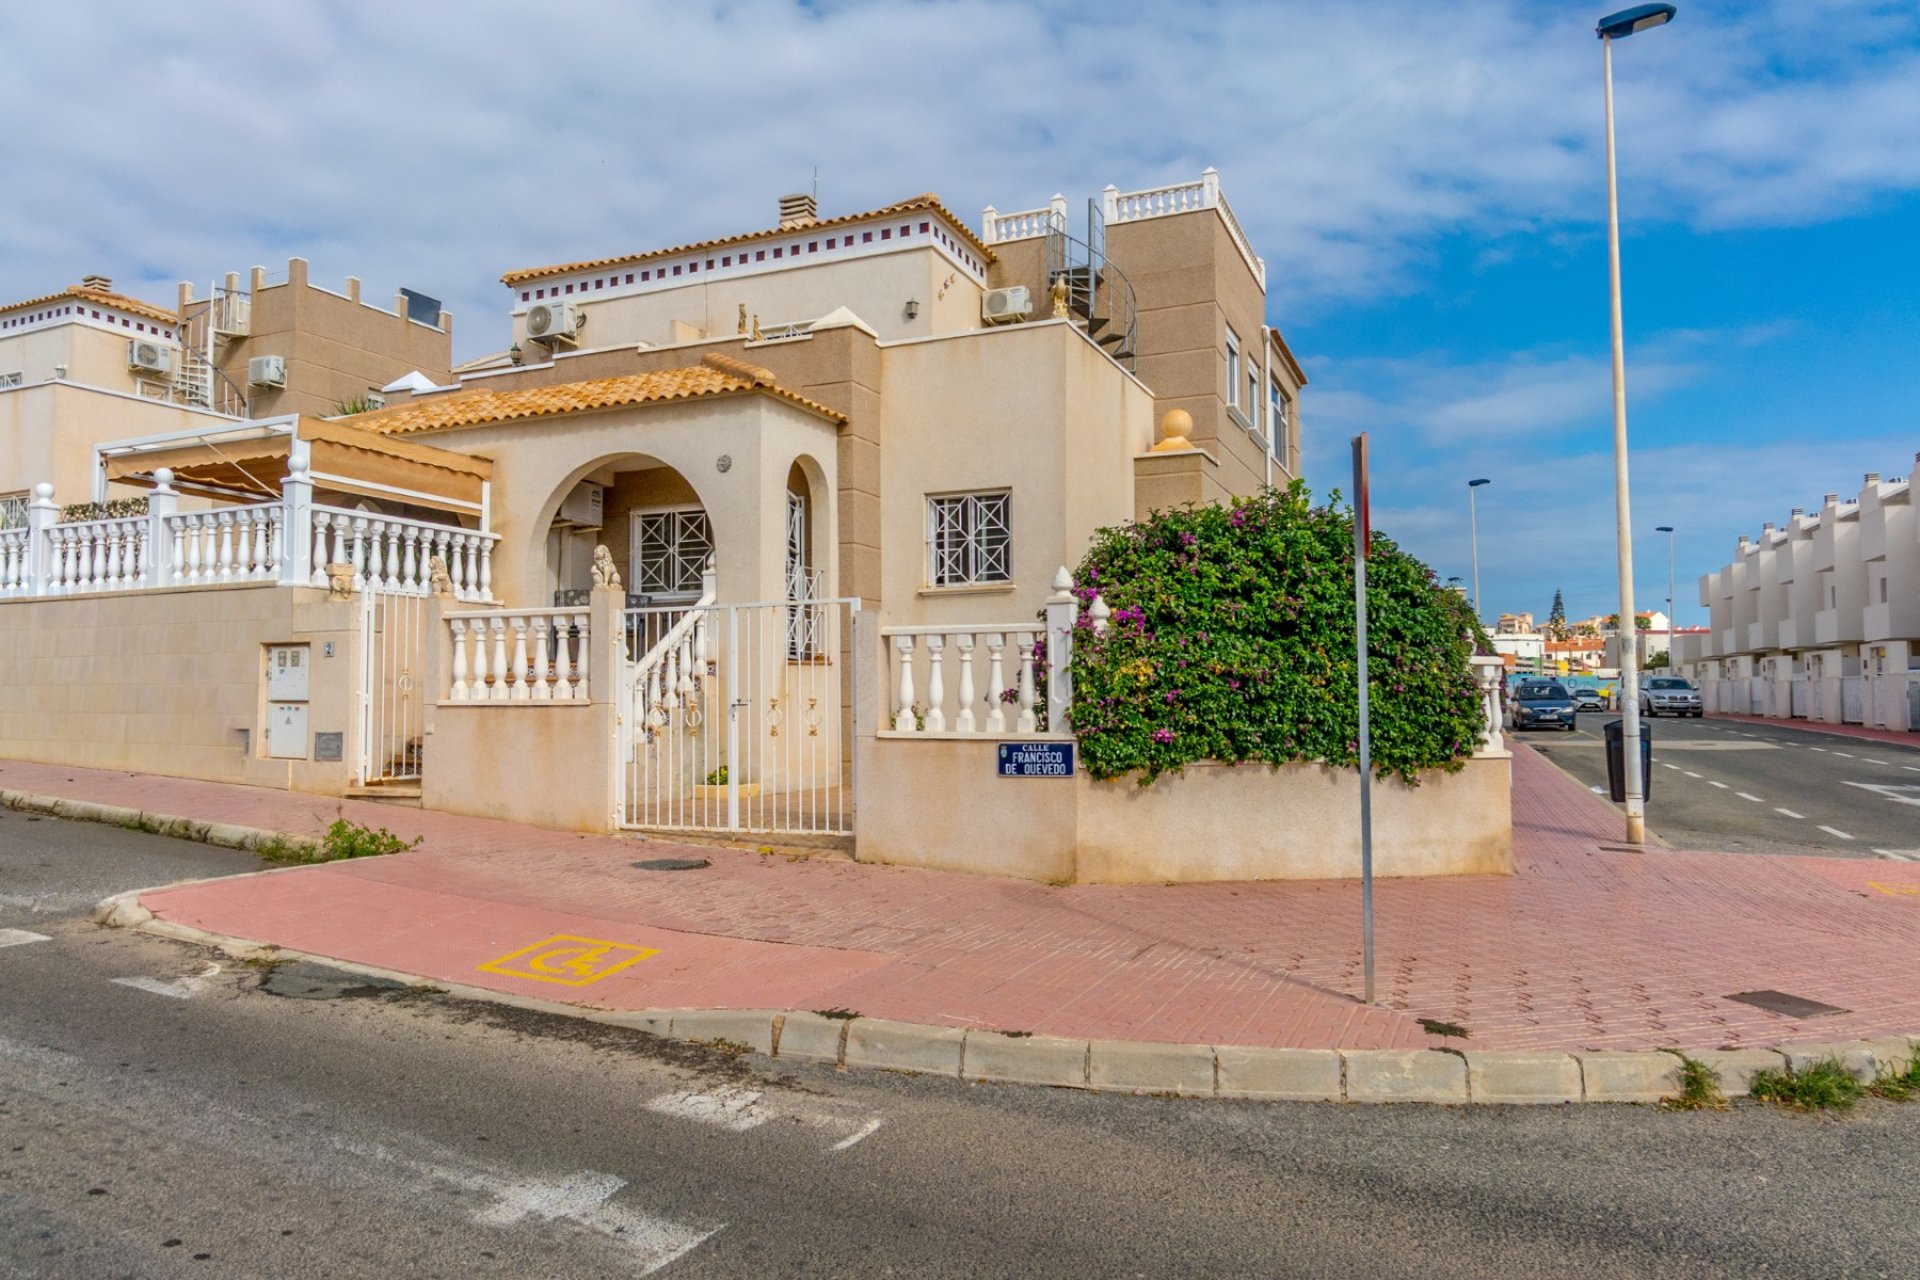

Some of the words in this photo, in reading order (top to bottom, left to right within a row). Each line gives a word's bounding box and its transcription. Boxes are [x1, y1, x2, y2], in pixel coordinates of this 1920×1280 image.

[326, 643, 332, 654] 2
[1022, 744, 1049, 752] CALLE
[1012, 752, 1063, 763] FRANCISCO
[1005, 763, 1017, 774] DE
[1024, 763, 1066, 774] QUEVEDO
